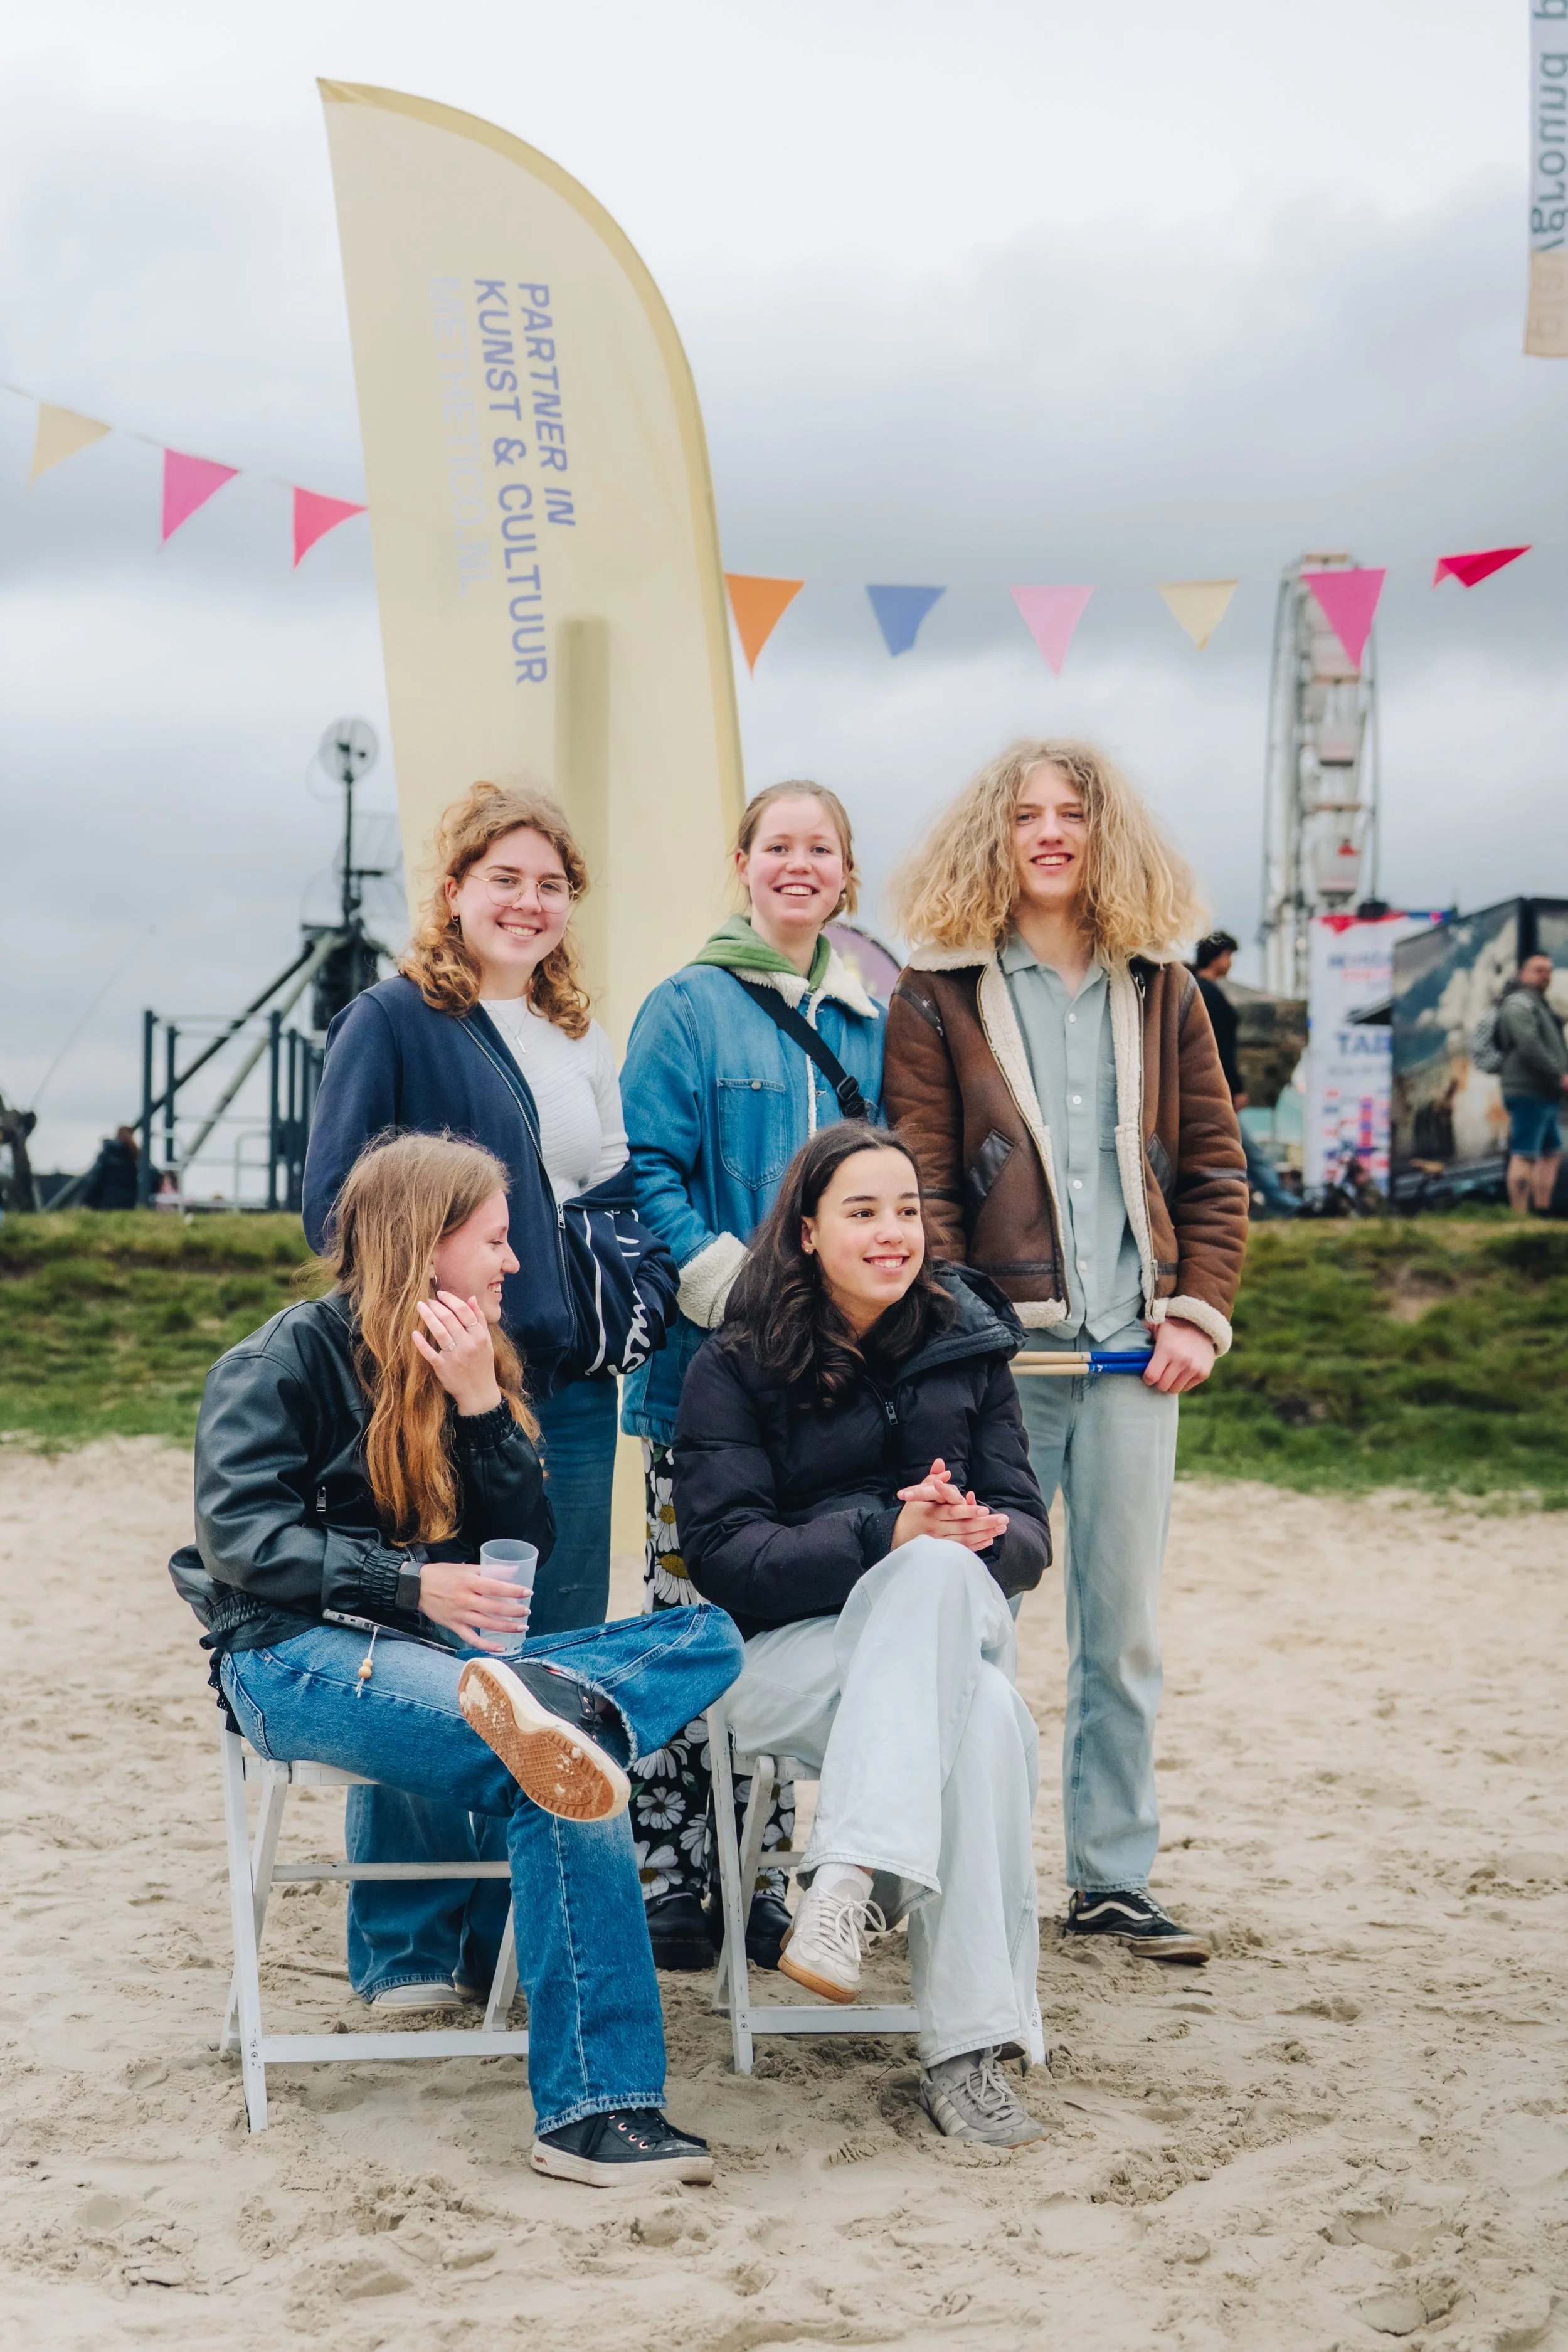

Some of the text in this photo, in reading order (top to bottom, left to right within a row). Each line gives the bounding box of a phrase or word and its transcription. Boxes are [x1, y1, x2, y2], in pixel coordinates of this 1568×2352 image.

[429, 277, 493, 597] METHETICO.NL
[474, 279, 548, 684] KUNST & CULTUUR
[519, 280, 576, 526] PARTNER IN
